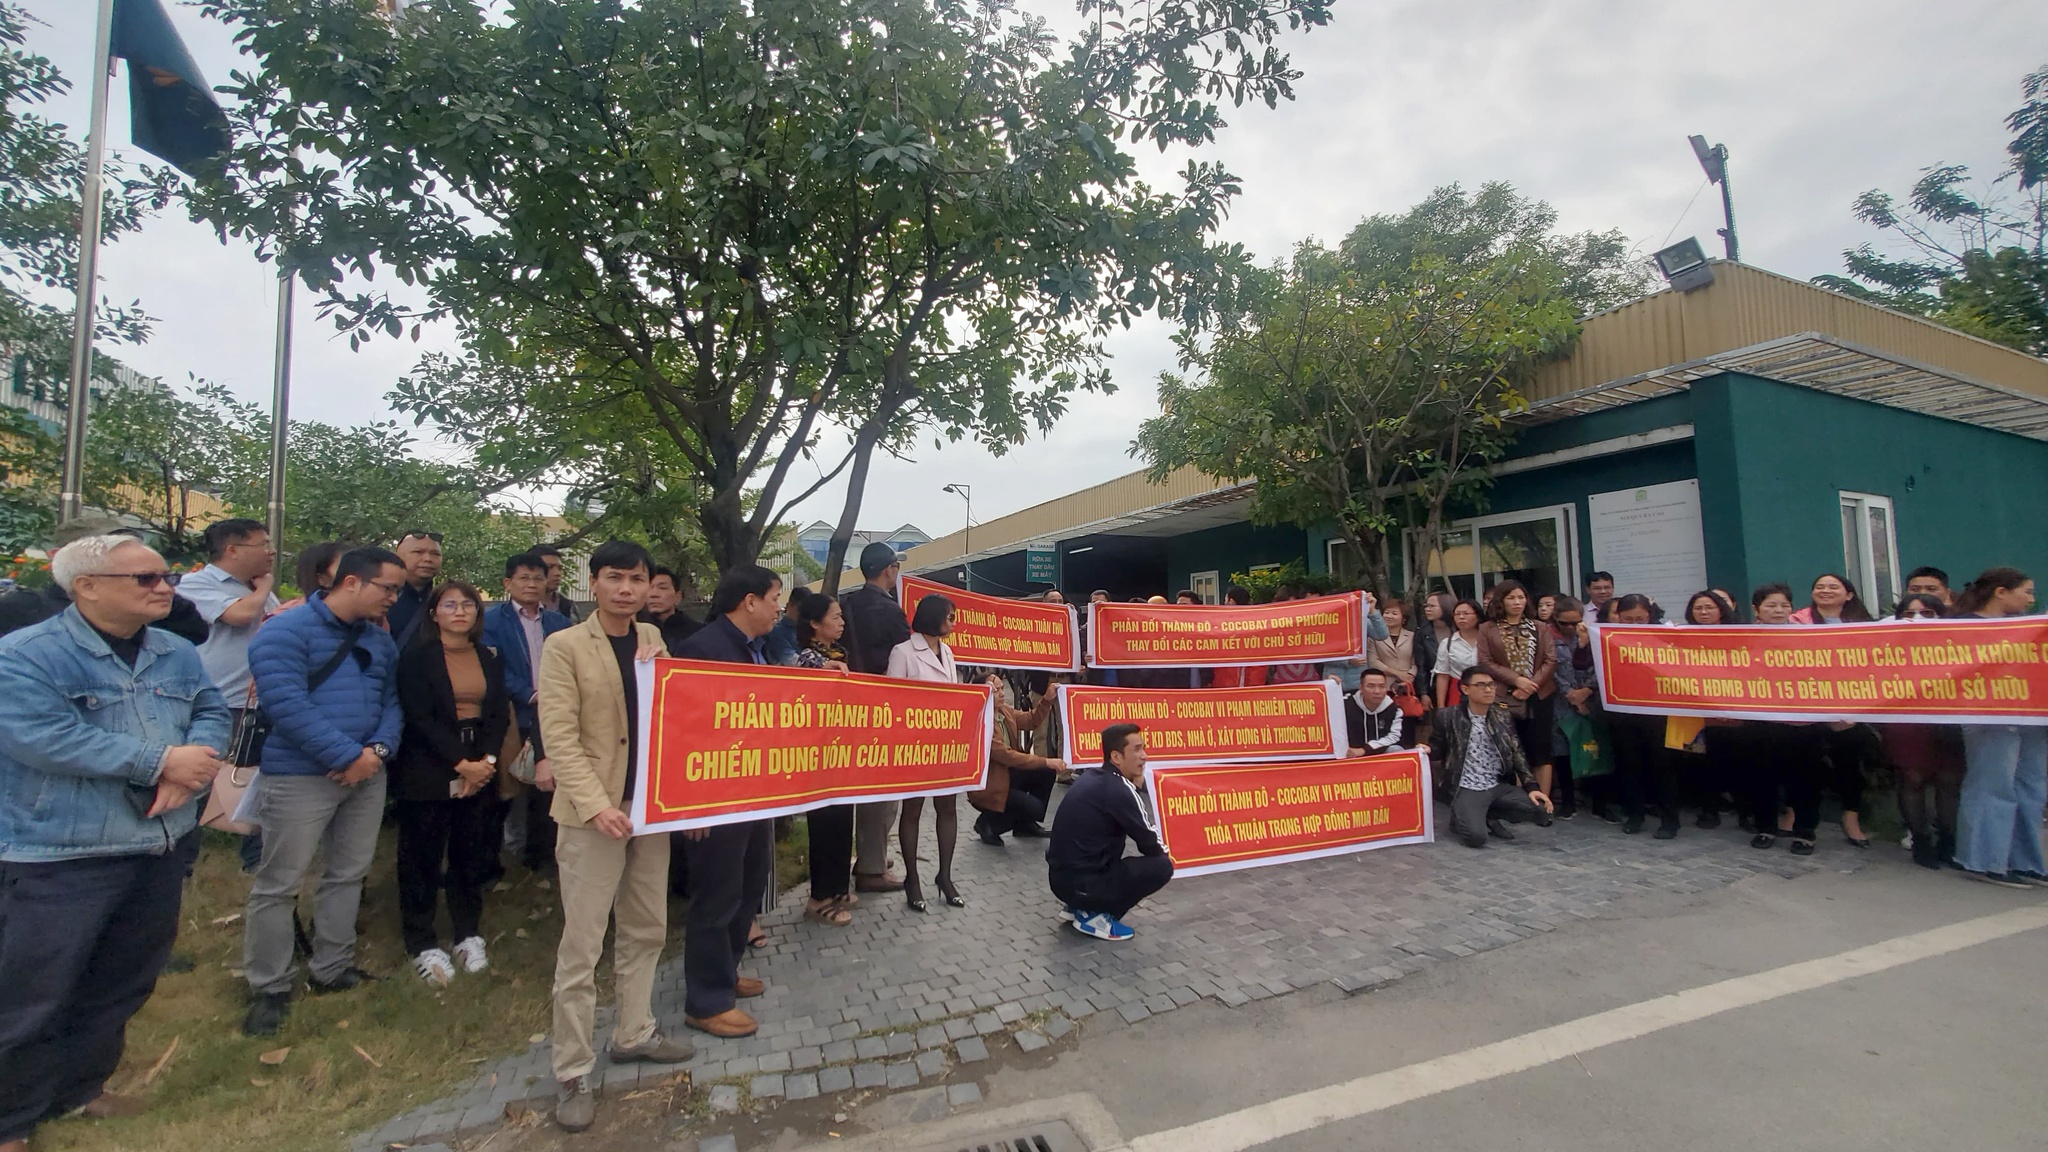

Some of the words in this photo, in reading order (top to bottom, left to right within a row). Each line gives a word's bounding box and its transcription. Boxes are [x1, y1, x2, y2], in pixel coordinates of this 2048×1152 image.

[962, 608, 987, 626] THÀNH
[987, 612, 997, 628] ĐÔ
[1003, 616, 1034, 632] COCOBAY
[1034, 618, 1052, 634] TUÂN
[1052, 618, 1064, 635] THỦ
[1112, 618, 1139, 633] PHẢN
[1142, 618, 1159, 632] ĐỐI
[1161, 620, 1195, 632] THÀNH
[1197, 620, 1211, 632] ĐÔ
[1221, 619, 1268, 632] COCOBAY
[1270, 617, 1294, 629] ĐƠN
[1296, 612, 1340, 628] PHƯƠNG
[957, 629, 972, 648] KẾT
[973, 634, 998, 650] TRONG
[998, 637, 1012, 654] HỢP
[1032, 641, 1048, 654] MUA
[1047, 640, 1061, 656] BÁN
[1126, 640, 1150, 652] THAY
[1172, 637, 1193, 651] CÁC
[1196, 639, 1219, 650] CAM
[1222, 634, 1241, 650] KẾT
[1244, 635, 1261, 649] VỚI
[1263, 632, 1285, 648] CHỦ
[1287, 631, 1302, 647] SỞ
[1304, 631, 1326, 645] HỮU
[1619, 642, 1655, 664] PHẢN
[1657, 642, 1681, 666] ĐỐI
[1682, 645, 1729, 668] THÀNH
[1730, 645, 1751, 668] ĐÔ
[1764, 648, 1832, 668] COCOBAY
[1836, 647, 1869, 668] THU
[1872, 643, 1907, 667] CÁC
[1909, 639, 1973, 666] KHOẢN
[1975, 639, 2040, 664] KHÔNG
[1655, 676, 1700, 696] TRONG
[1702, 679, 1745, 699] HĐMB
[1747, 676, 1773, 699] VỚI
[1775, 681, 1795, 699] 15
[1797, 676, 1834, 700] ĐÊM
[1836, 673, 1878, 700] NGHỈ
[1881, 673, 1918, 700] CỦA
[1920, 672, 1957, 700] CHỦ
[1961, 672, 1987, 700] SỞ
[1990, 674, 2030, 701] HỮU
[714, 693, 774, 729] PHẢN
[779, 694, 812, 729] ĐỐI
[816, 699, 869, 728] THÀNH
[872, 702, 893, 729] ĐÔ
[905, 707, 964, 730] COCOBAY
[1083, 697, 1108, 720] PHẢN
[1110, 697, 1126, 719] ĐỐI
[1127, 699, 1156, 719] THÀNH
[1157, 699, 1169, 719] ĐÔ
[1177, 701, 1215, 719] COCOBAY
[1216, 702, 1226, 717] VI
[1227, 701, 1252, 721] PHẠM
[1253, 696, 1286, 716] NGHIÊM
[1287, 699, 1316, 719] TRỌNG
[1078, 729, 1102, 750] PHÁP
[1151, 731, 1164, 749] KD
[1165, 730, 1187, 749] BDS,
[1187, 726, 1206, 747] NHÀ
[1217, 725, 1234, 746] XÂY
[1236, 727, 1260, 749] DỰNG
[1260, 724, 1273, 745] VÀ
[1273, 725, 1307, 744] THƯƠNG
[1307, 726, 1325, 746] MẠI
[686, 740, 762, 782] CHIẾM
[768, 745, 819, 780] DỤNG
[822, 736, 852, 770] VỐN
[856, 736, 889, 768] CỦA
[893, 740, 939, 767] KHÁCH
[940, 740, 970, 765] HÀNG
[1167, 790, 1198, 816] PHẢN
[1199, 787, 1218, 814] ĐỐI
[1218, 788, 1253, 812] THÀNH
[1254, 785, 1269, 808] ĐÔ
[1276, 785, 1321, 806] COCOBAY
[1321, 784, 1333, 803] VI
[1333, 781, 1362, 804] PHẠM
[1362, 775, 1385, 798] ĐIỀU
[1385, 772, 1414, 796] KHOẢN
[1204, 819, 1232, 846] THỎA
[1232, 817, 1268, 844] THUẬN
[1267, 816, 1302, 838] TRONG
[1301, 813, 1323, 838] HỢP
[1323, 807, 1351, 831] ĐỒNG
[1351, 809, 1372, 829] MUA
[1372, 805, 1391, 826] BÁN
